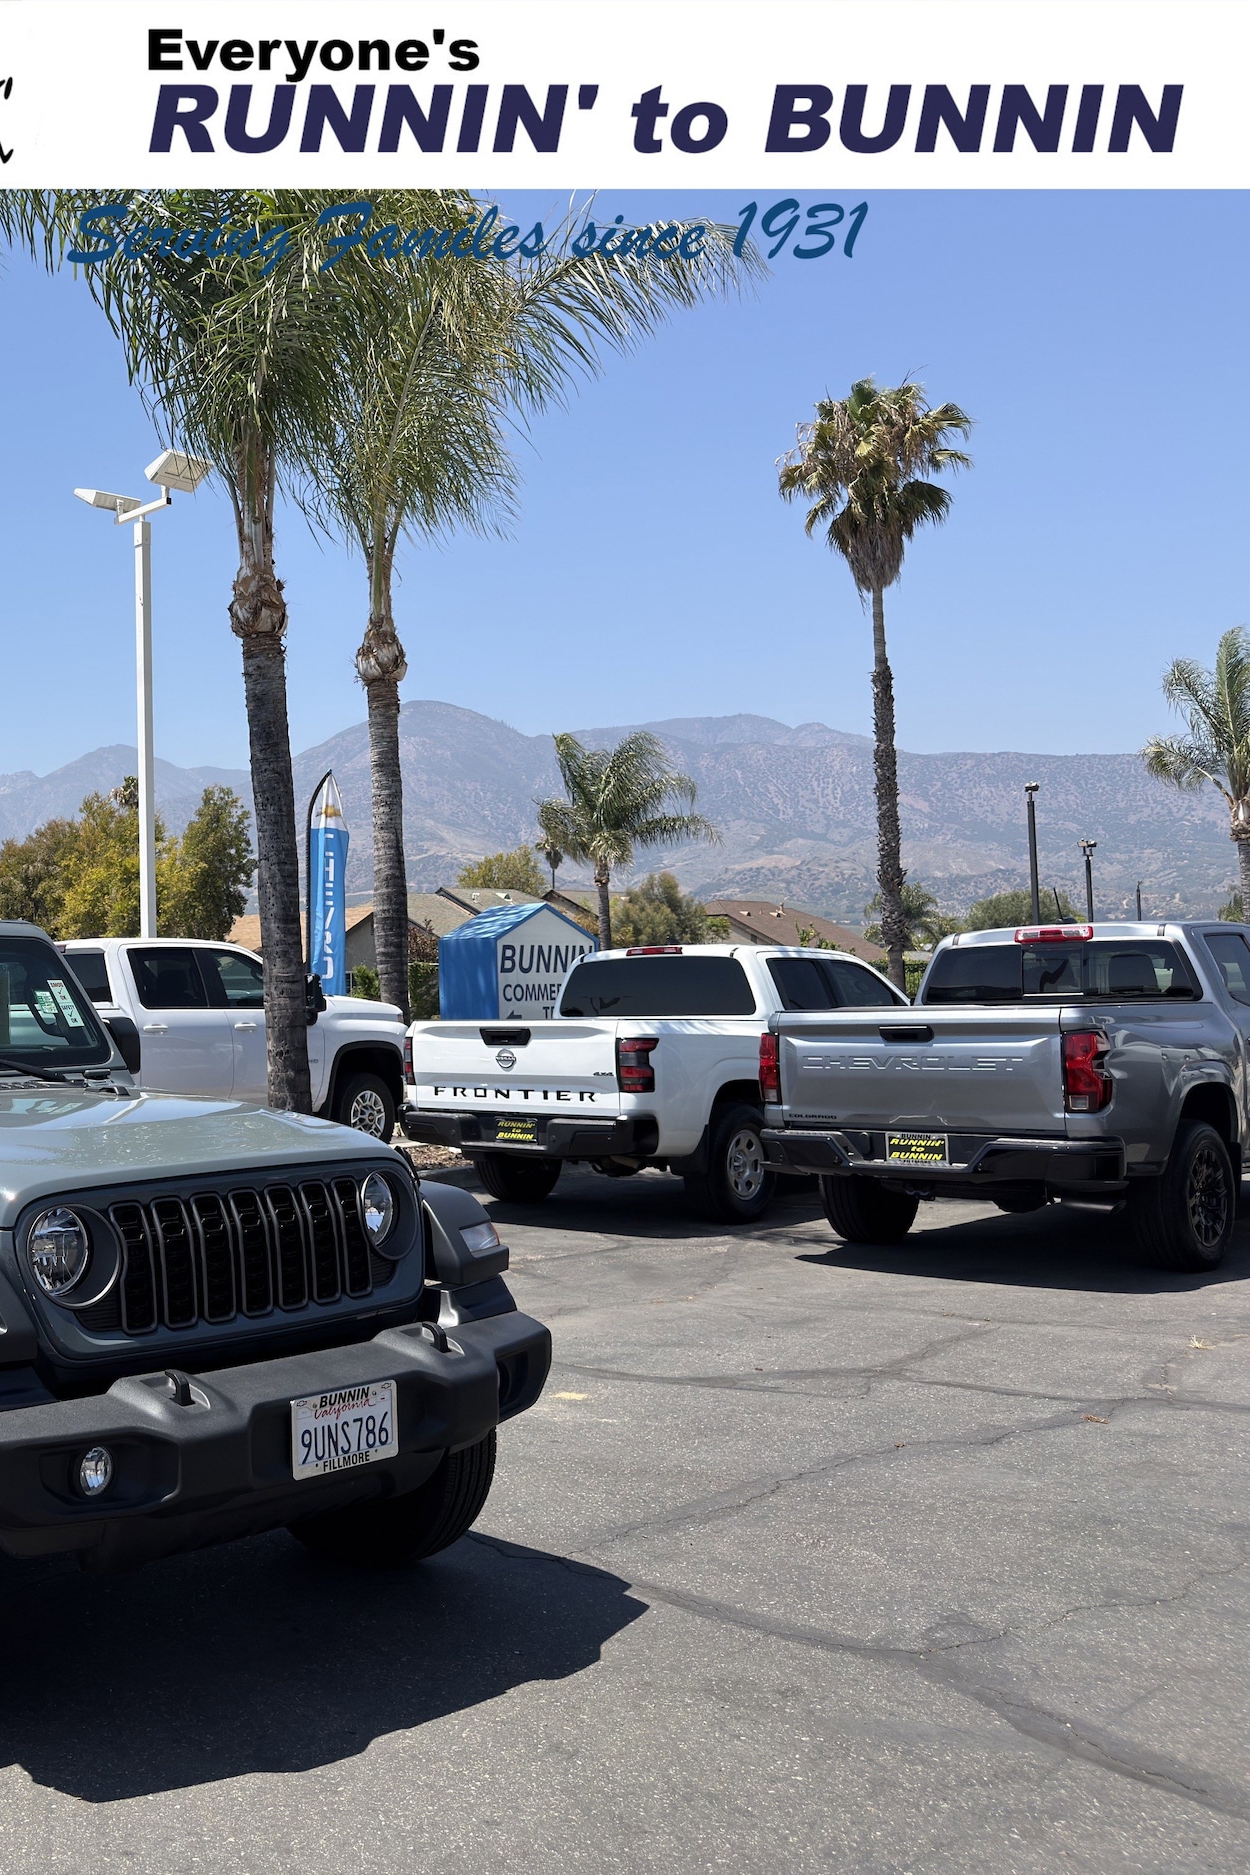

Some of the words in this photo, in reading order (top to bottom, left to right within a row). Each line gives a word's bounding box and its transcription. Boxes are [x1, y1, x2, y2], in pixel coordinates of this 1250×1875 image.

[803, 1056, 1023, 1071] CHEVROLET
[434, 1086, 596, 1103] FRONTIER
[889, 1138, 945, 1147] RUNNIN'
[890, 1151, 943, 1161] BUNNIN
[319, 1386, 371, 1409] BUNNIN
[314, 1397, 376, 1420] California
[301, 1411, 389, 1465] 9UNS786
[323, 1450, 370, 1473] FILLMORE
